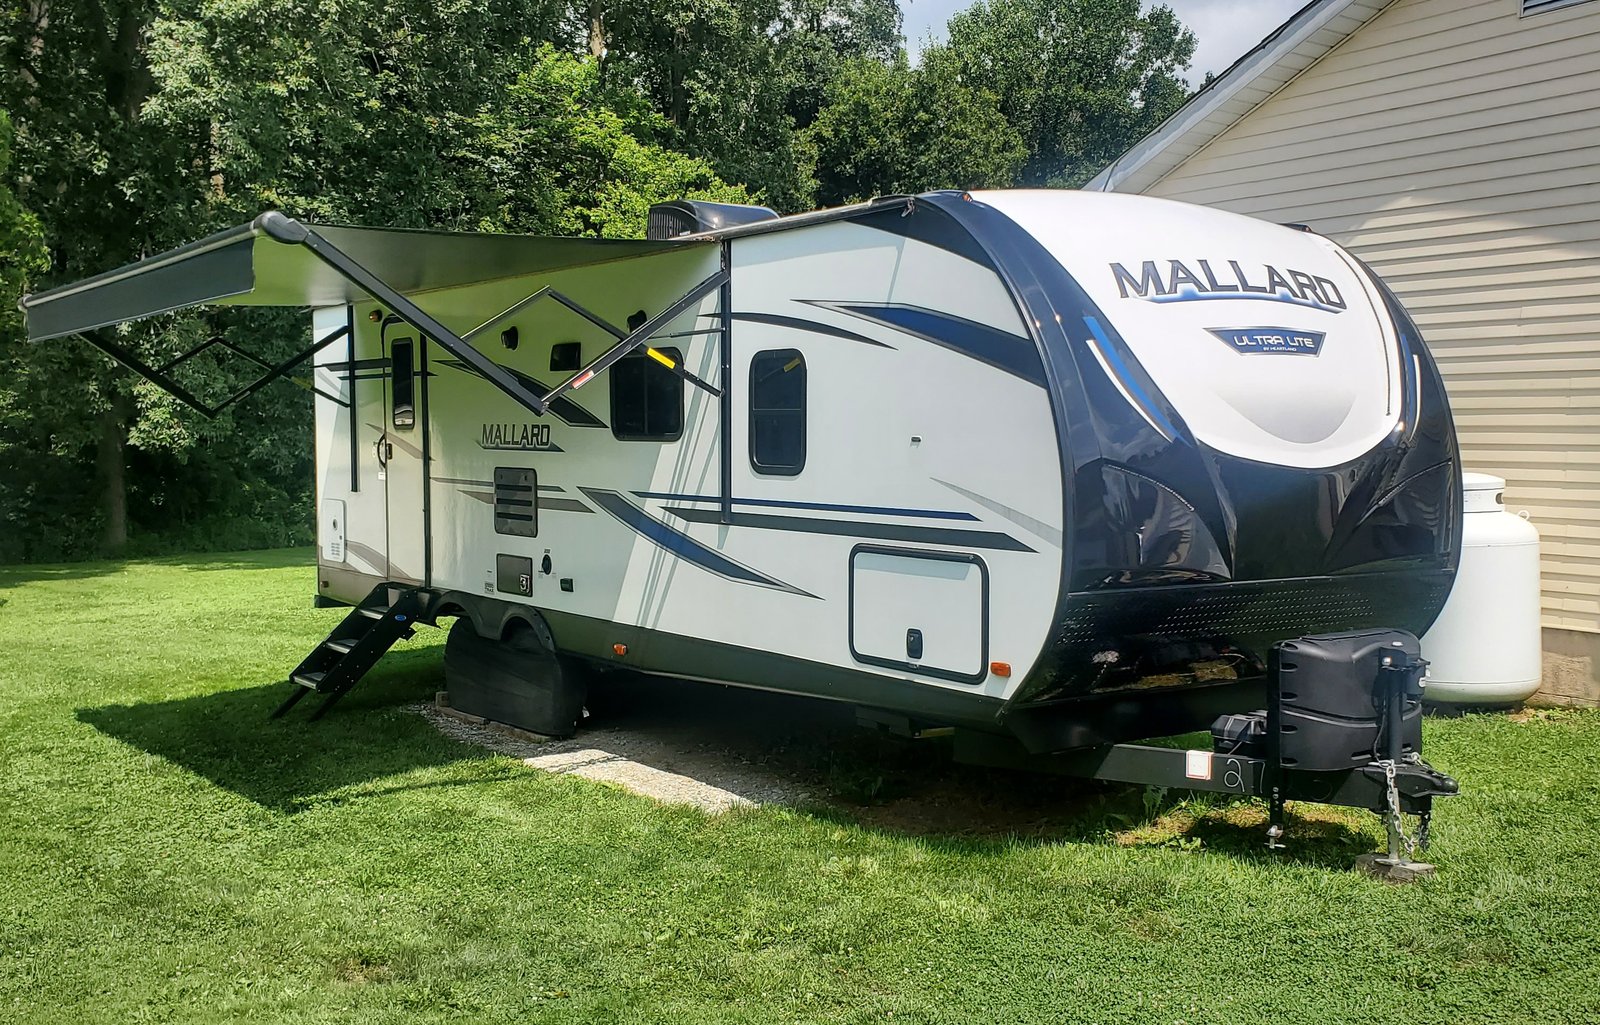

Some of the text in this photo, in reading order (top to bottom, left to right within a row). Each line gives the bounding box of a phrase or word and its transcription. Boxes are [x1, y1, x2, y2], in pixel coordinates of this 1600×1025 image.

[1109, 259, 1347, 310] MALLARD
[1233, 335, 1315, 348] ULTRA LITE
[481, 423, 551, 447] MALLARD
